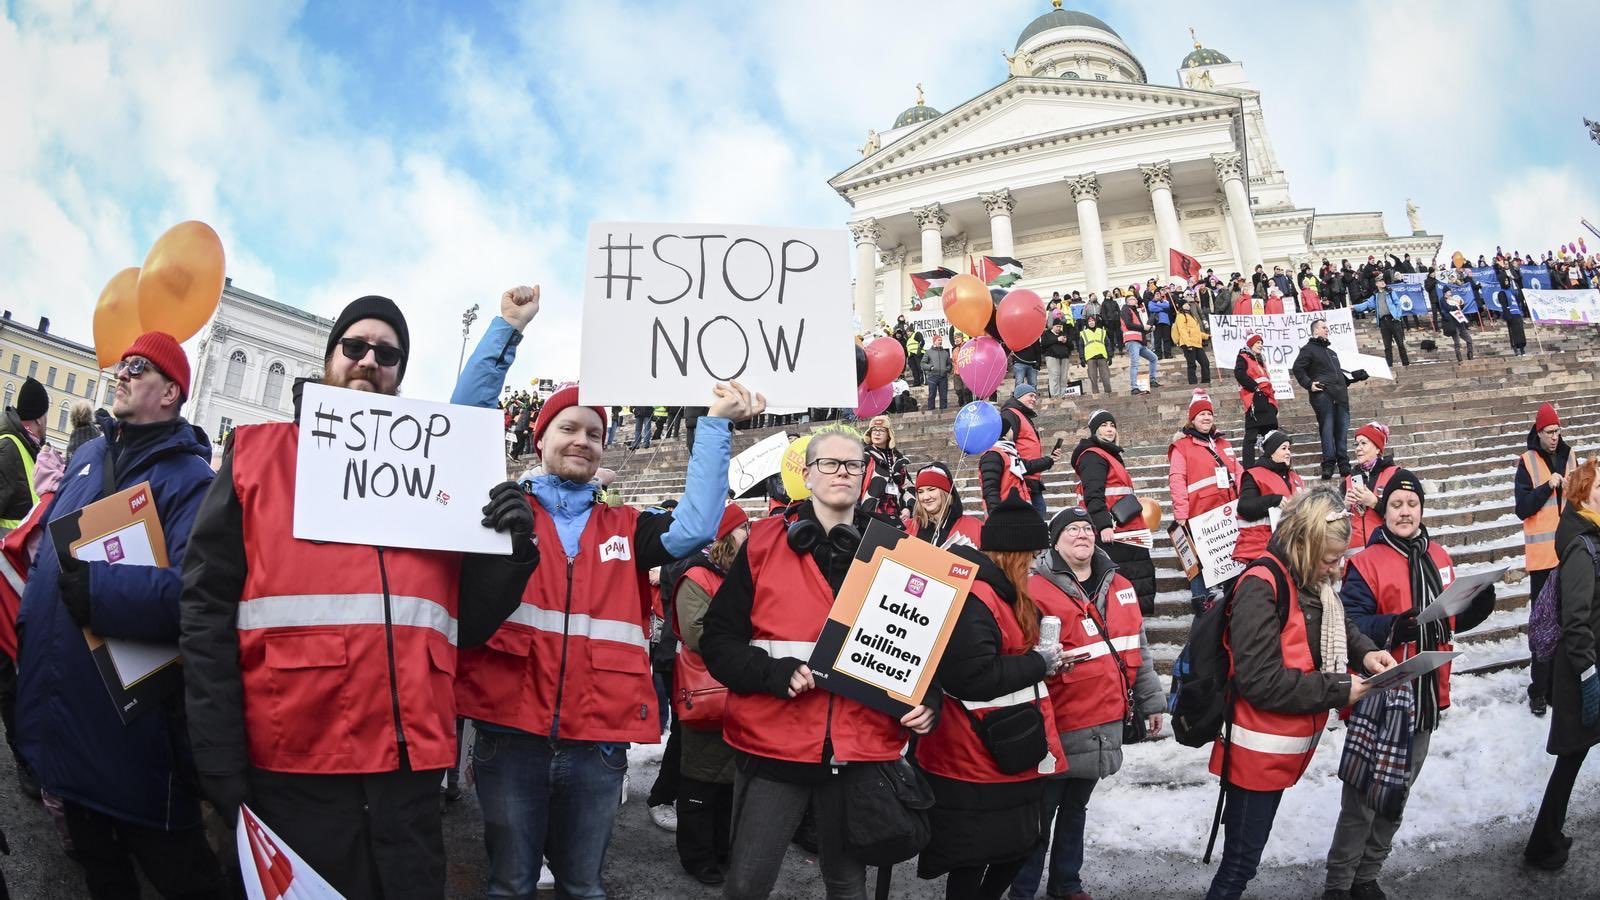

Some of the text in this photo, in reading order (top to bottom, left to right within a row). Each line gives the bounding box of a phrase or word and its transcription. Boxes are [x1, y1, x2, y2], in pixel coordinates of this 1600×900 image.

[594, 232, 819, 304] #STOP
[1214, 315, 1275, 328] VALHEILLA
[651, 315, 805, 381] NOW
[311, 402, 451, 459] #STOP
[343, 458, 435, 500] NOW
[131, 494, 146, 509] PAM
[605, 541, 626, 555] PAM
[952, 566, 969, 576] PAM
[878, 594, 930, 627] Lakko
[886, 623, 907, 639] on
[854, 628, 922, 667] laillinen
[850, 651, 912, 683] oikeus!
